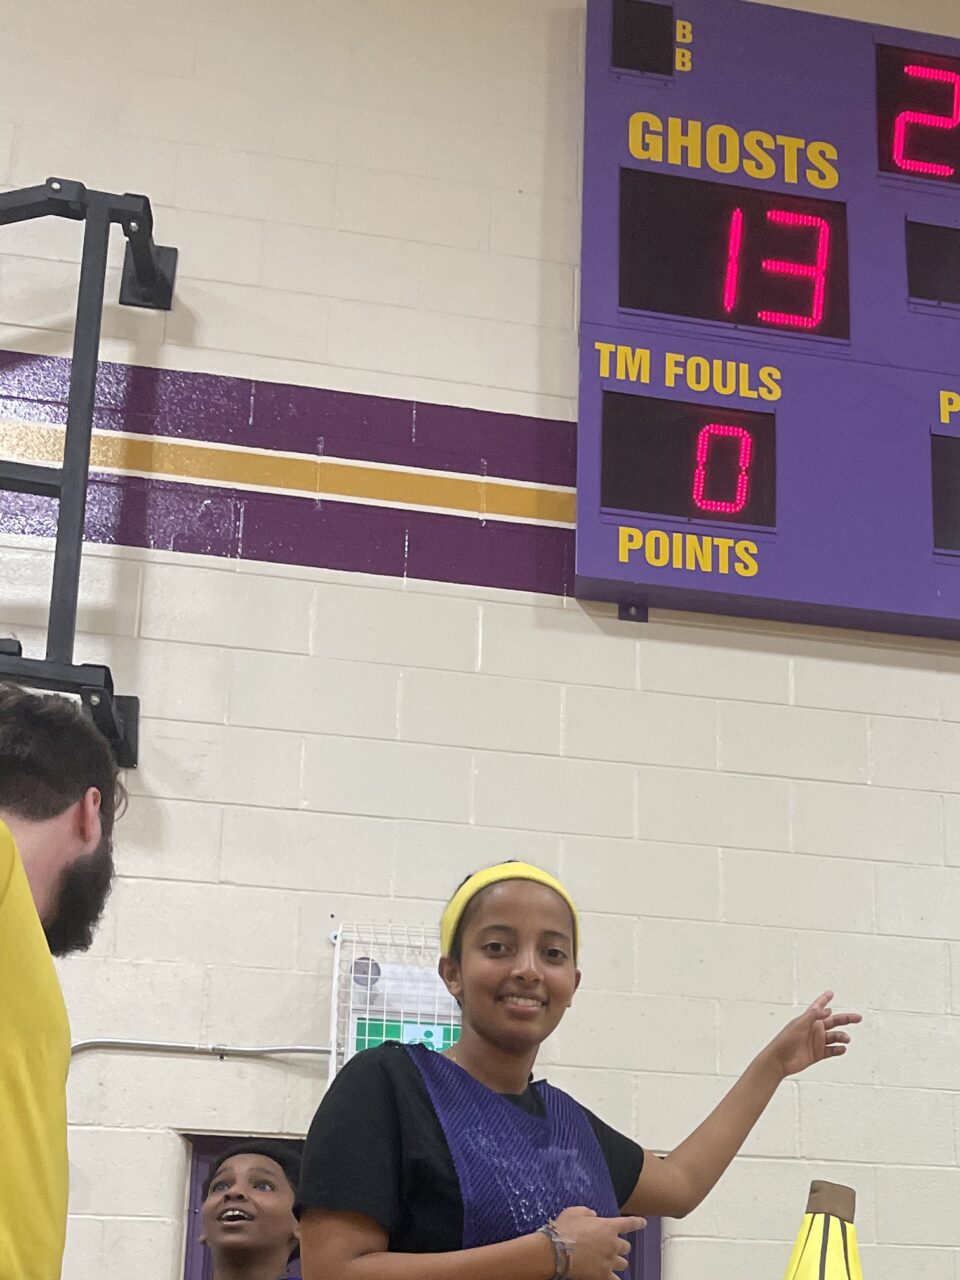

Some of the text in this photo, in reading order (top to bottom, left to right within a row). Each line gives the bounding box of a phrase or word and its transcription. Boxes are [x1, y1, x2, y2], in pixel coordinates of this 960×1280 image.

[675, 48, 692, 72] B
[676, 20, 693, 43] B
[628, 112, 840, 189] GHOSTS
[723, 207, 831, 329] 13
[594, 342, 782, 401] TM FOULS
[692, 423, 752, 514] 0
[618, 526, 759, 577] POINTS
